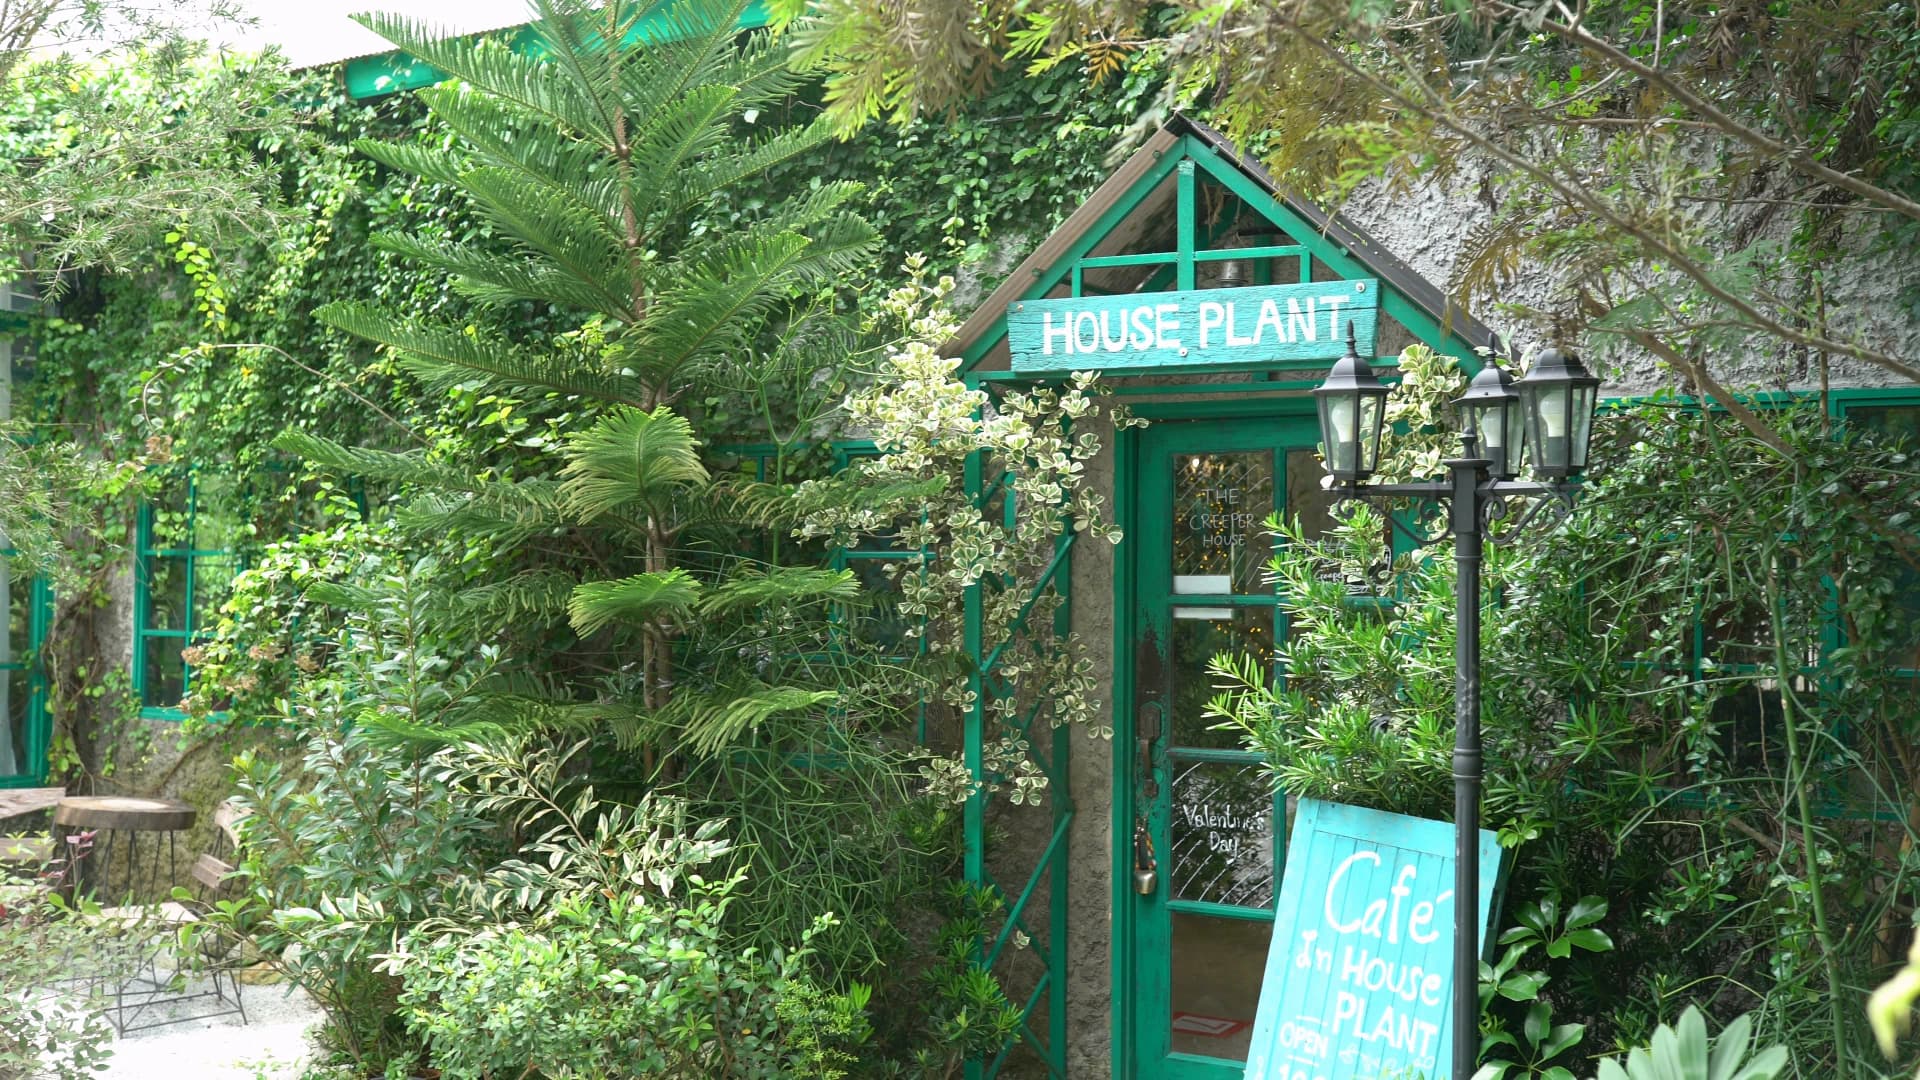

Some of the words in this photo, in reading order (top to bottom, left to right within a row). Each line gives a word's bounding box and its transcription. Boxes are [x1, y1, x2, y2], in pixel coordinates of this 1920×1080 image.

[1042, 303, 1181, 355] HOUSE
[1199, 294, 1351, 347] PLANT
[1201, 488, 1240, 505] THE
[1189, 512, 1256, 531] CREEPER
[1203, 533, 1246, 548] HOUSE
[1209, 830, 1238, 865] Day
[1324, 850, 1454, 944] Café
[1295, 929, 1332, 974] In
[1279, 1022, 1329, 1058] OPEN
[1332, 991, 1438, 1057] PLANT
